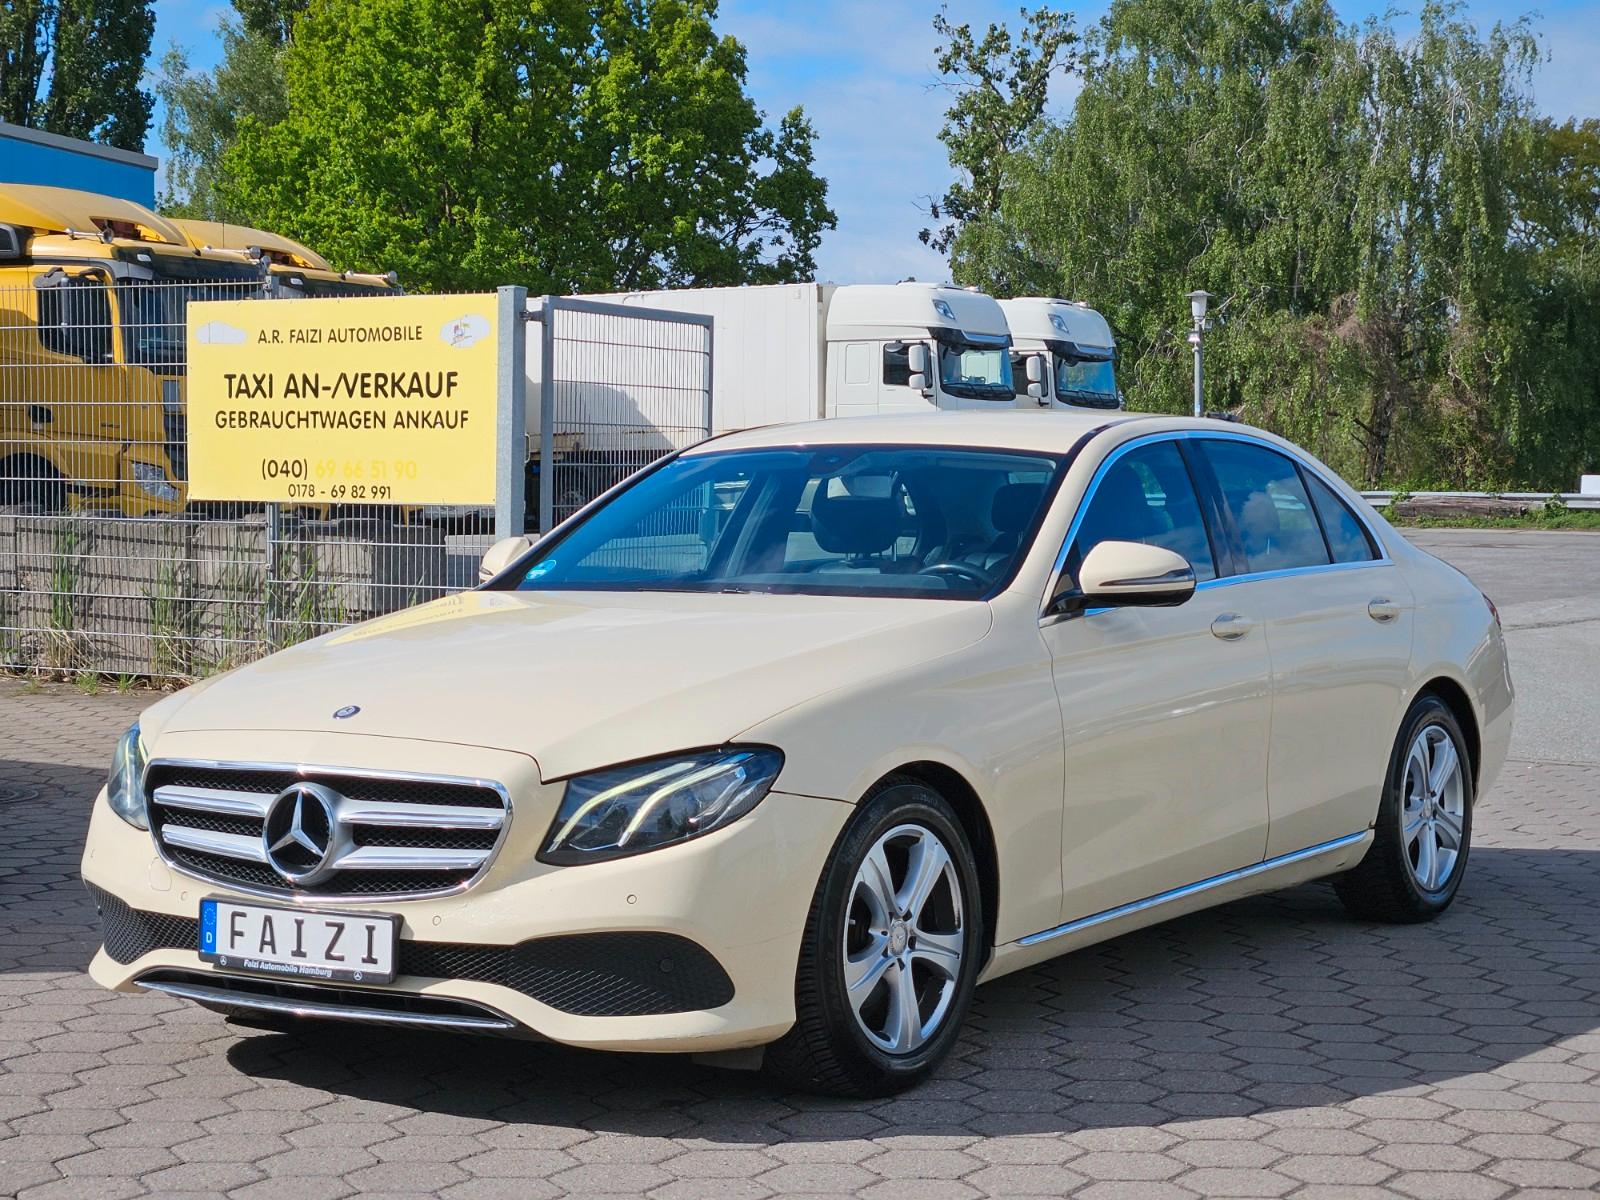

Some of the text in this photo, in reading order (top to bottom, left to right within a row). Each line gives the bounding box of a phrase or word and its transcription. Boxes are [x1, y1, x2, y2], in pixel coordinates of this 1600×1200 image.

[258, 325, 423, 345] A.R. FAIZI AUTOMOBILE
[223, 373, 273, 399] TAXI
[215, 410, 469, 429] GEBRAUCHTWAGEN ANKAUF
[262, 458, 308, 480] (040)
[288, 484, 315, 498] 0178
[330, 485, 346, 498] 69
[351, 485, 366, 499] 82
[371, 485, 391, 499] 991
[205, 931, 213, 944] D
[230, 911, 379, 965] FAIZI
[243, 959, 333, 978] Faizi Automobile Hamburg
